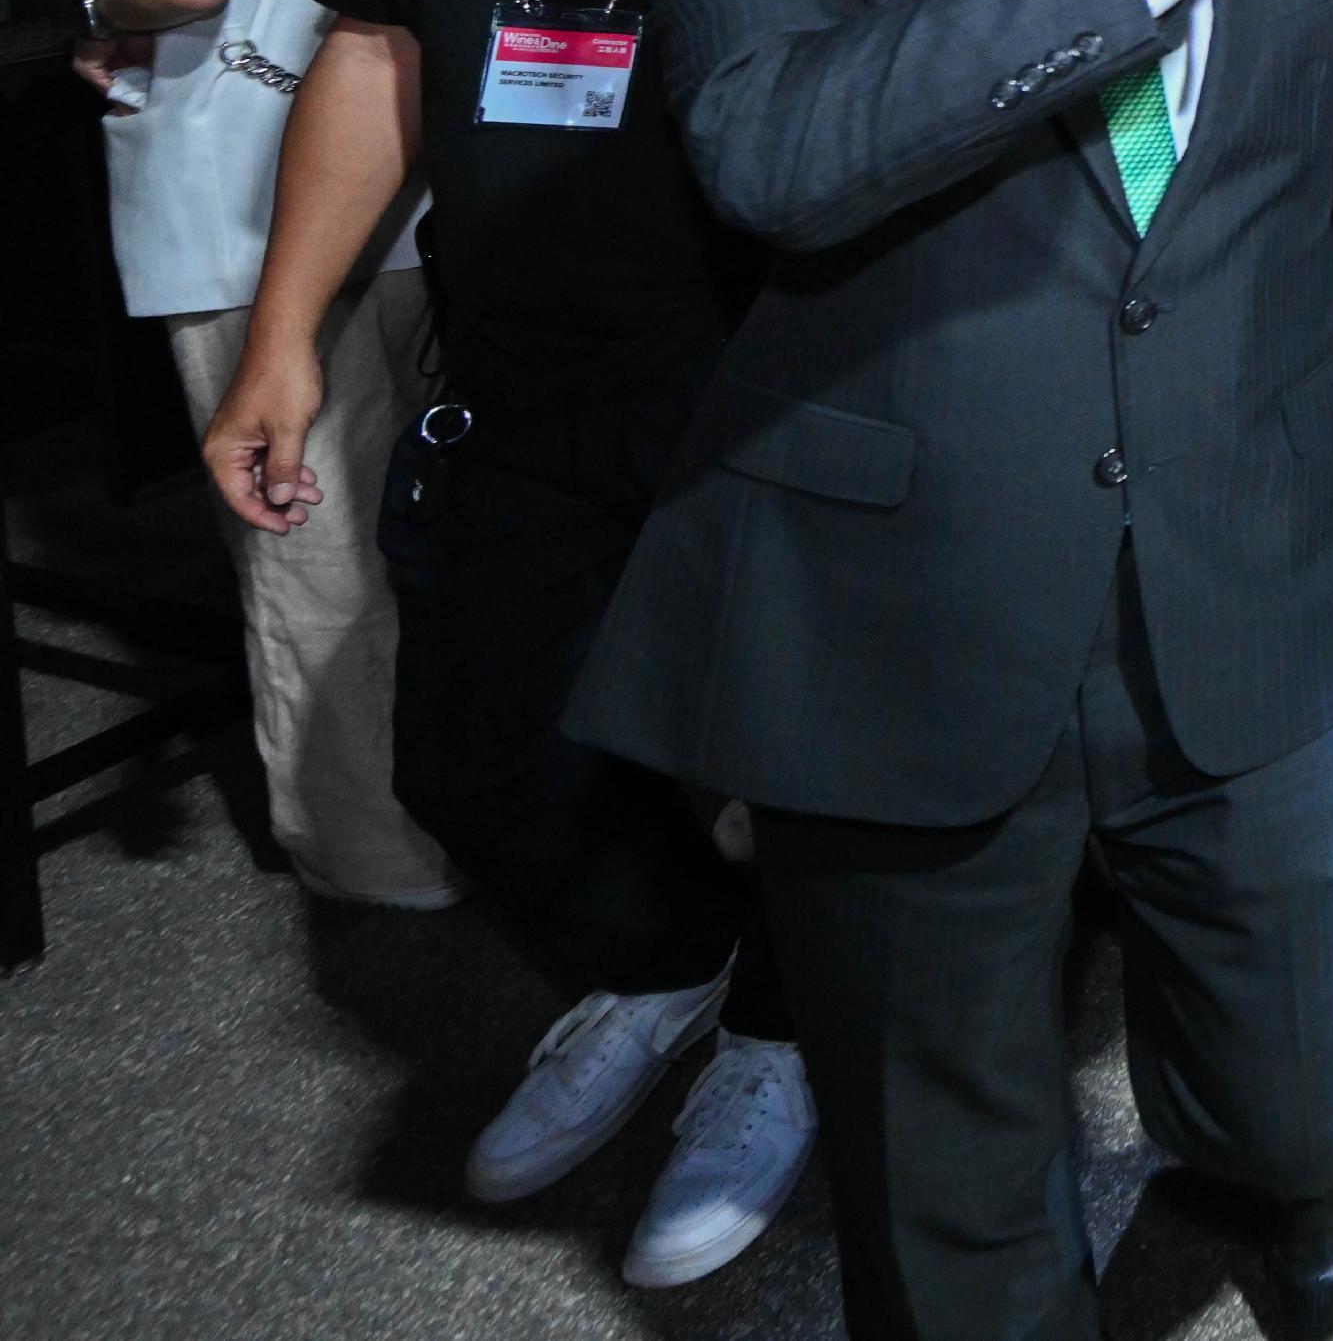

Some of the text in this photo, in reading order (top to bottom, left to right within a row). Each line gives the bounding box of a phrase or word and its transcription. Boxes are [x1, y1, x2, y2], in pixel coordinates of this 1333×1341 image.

[501, 69, 583, 81] MACROTECH SECURITY
[499, 78, 533, 87] SERVICES
